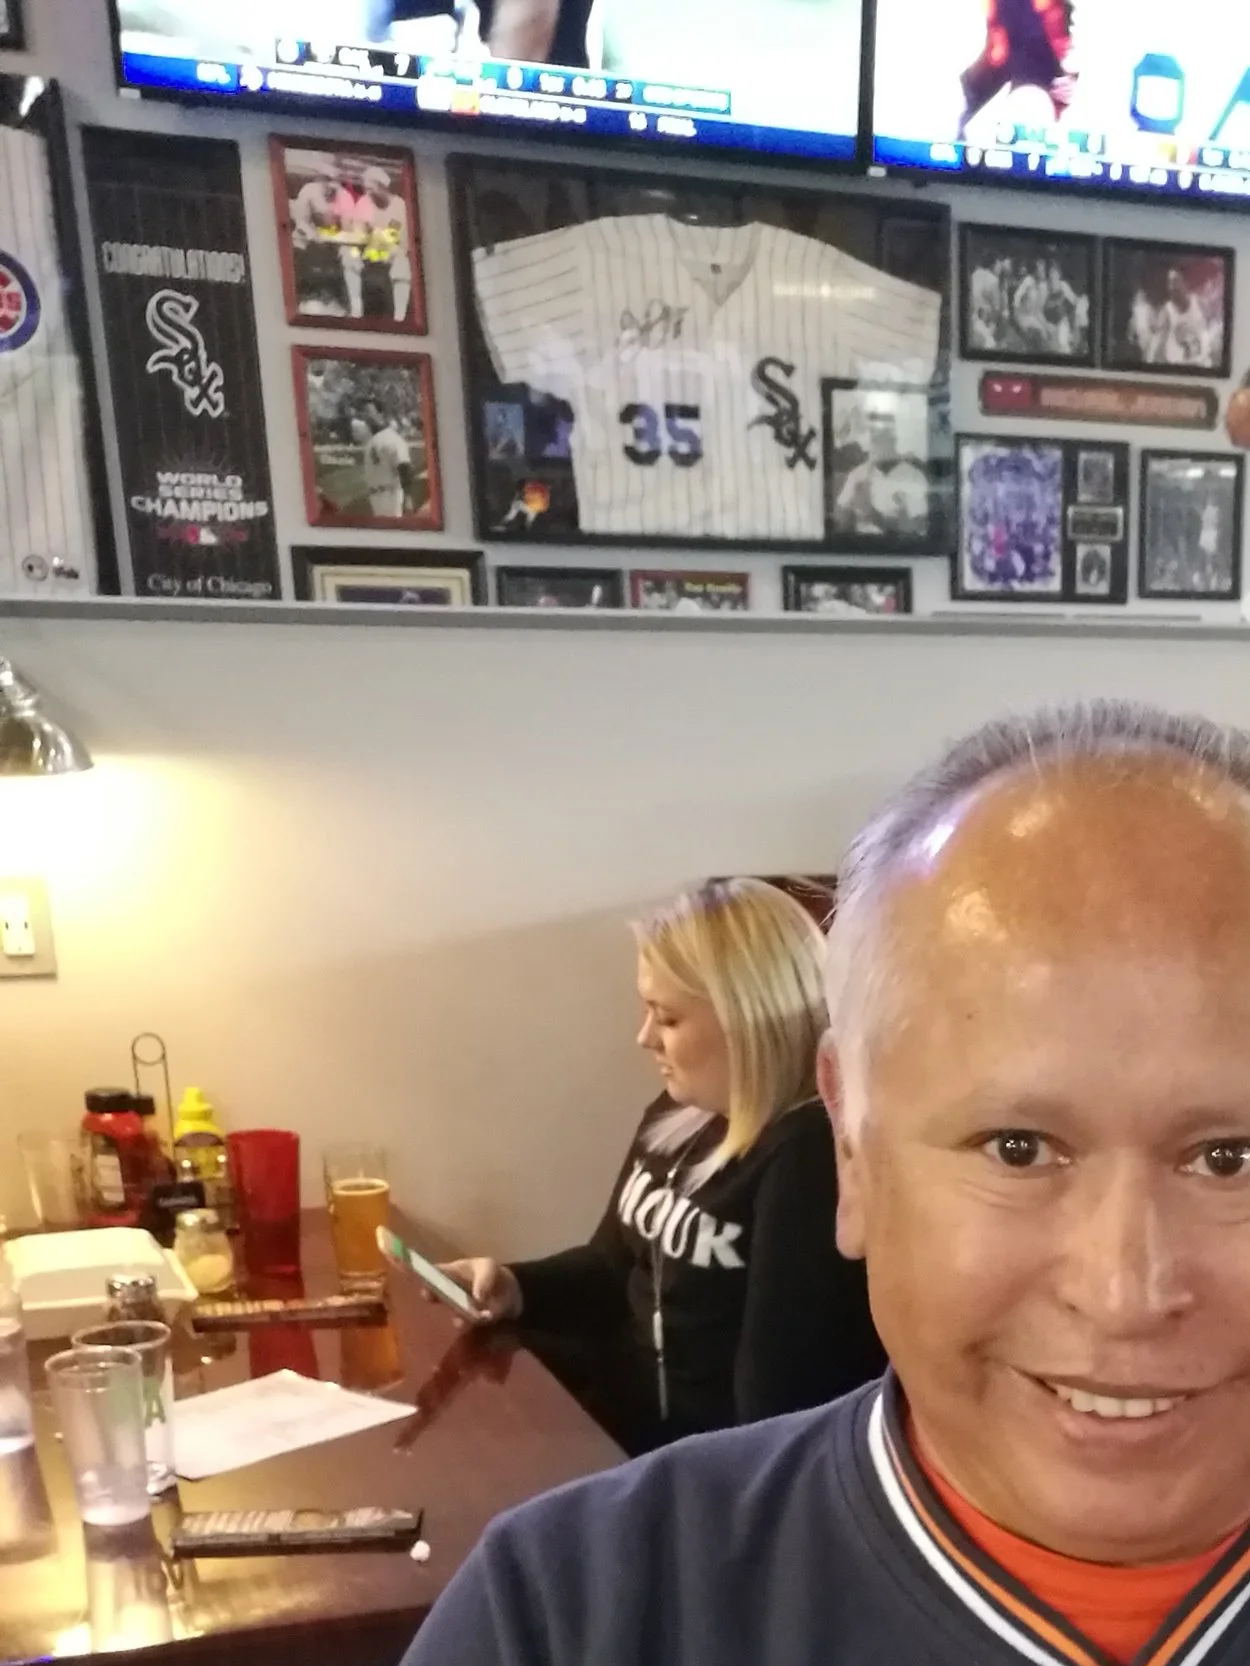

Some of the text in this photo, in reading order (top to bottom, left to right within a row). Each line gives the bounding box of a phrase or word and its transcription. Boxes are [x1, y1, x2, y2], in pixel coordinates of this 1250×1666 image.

[619, 404, 704, 467] 35
[156, 472, 242, 487] WORLD
[130, 496, 268, 522] CHAMPIONS
[147, 573, 181, 596] City
[186, 575, 204, 592] of
